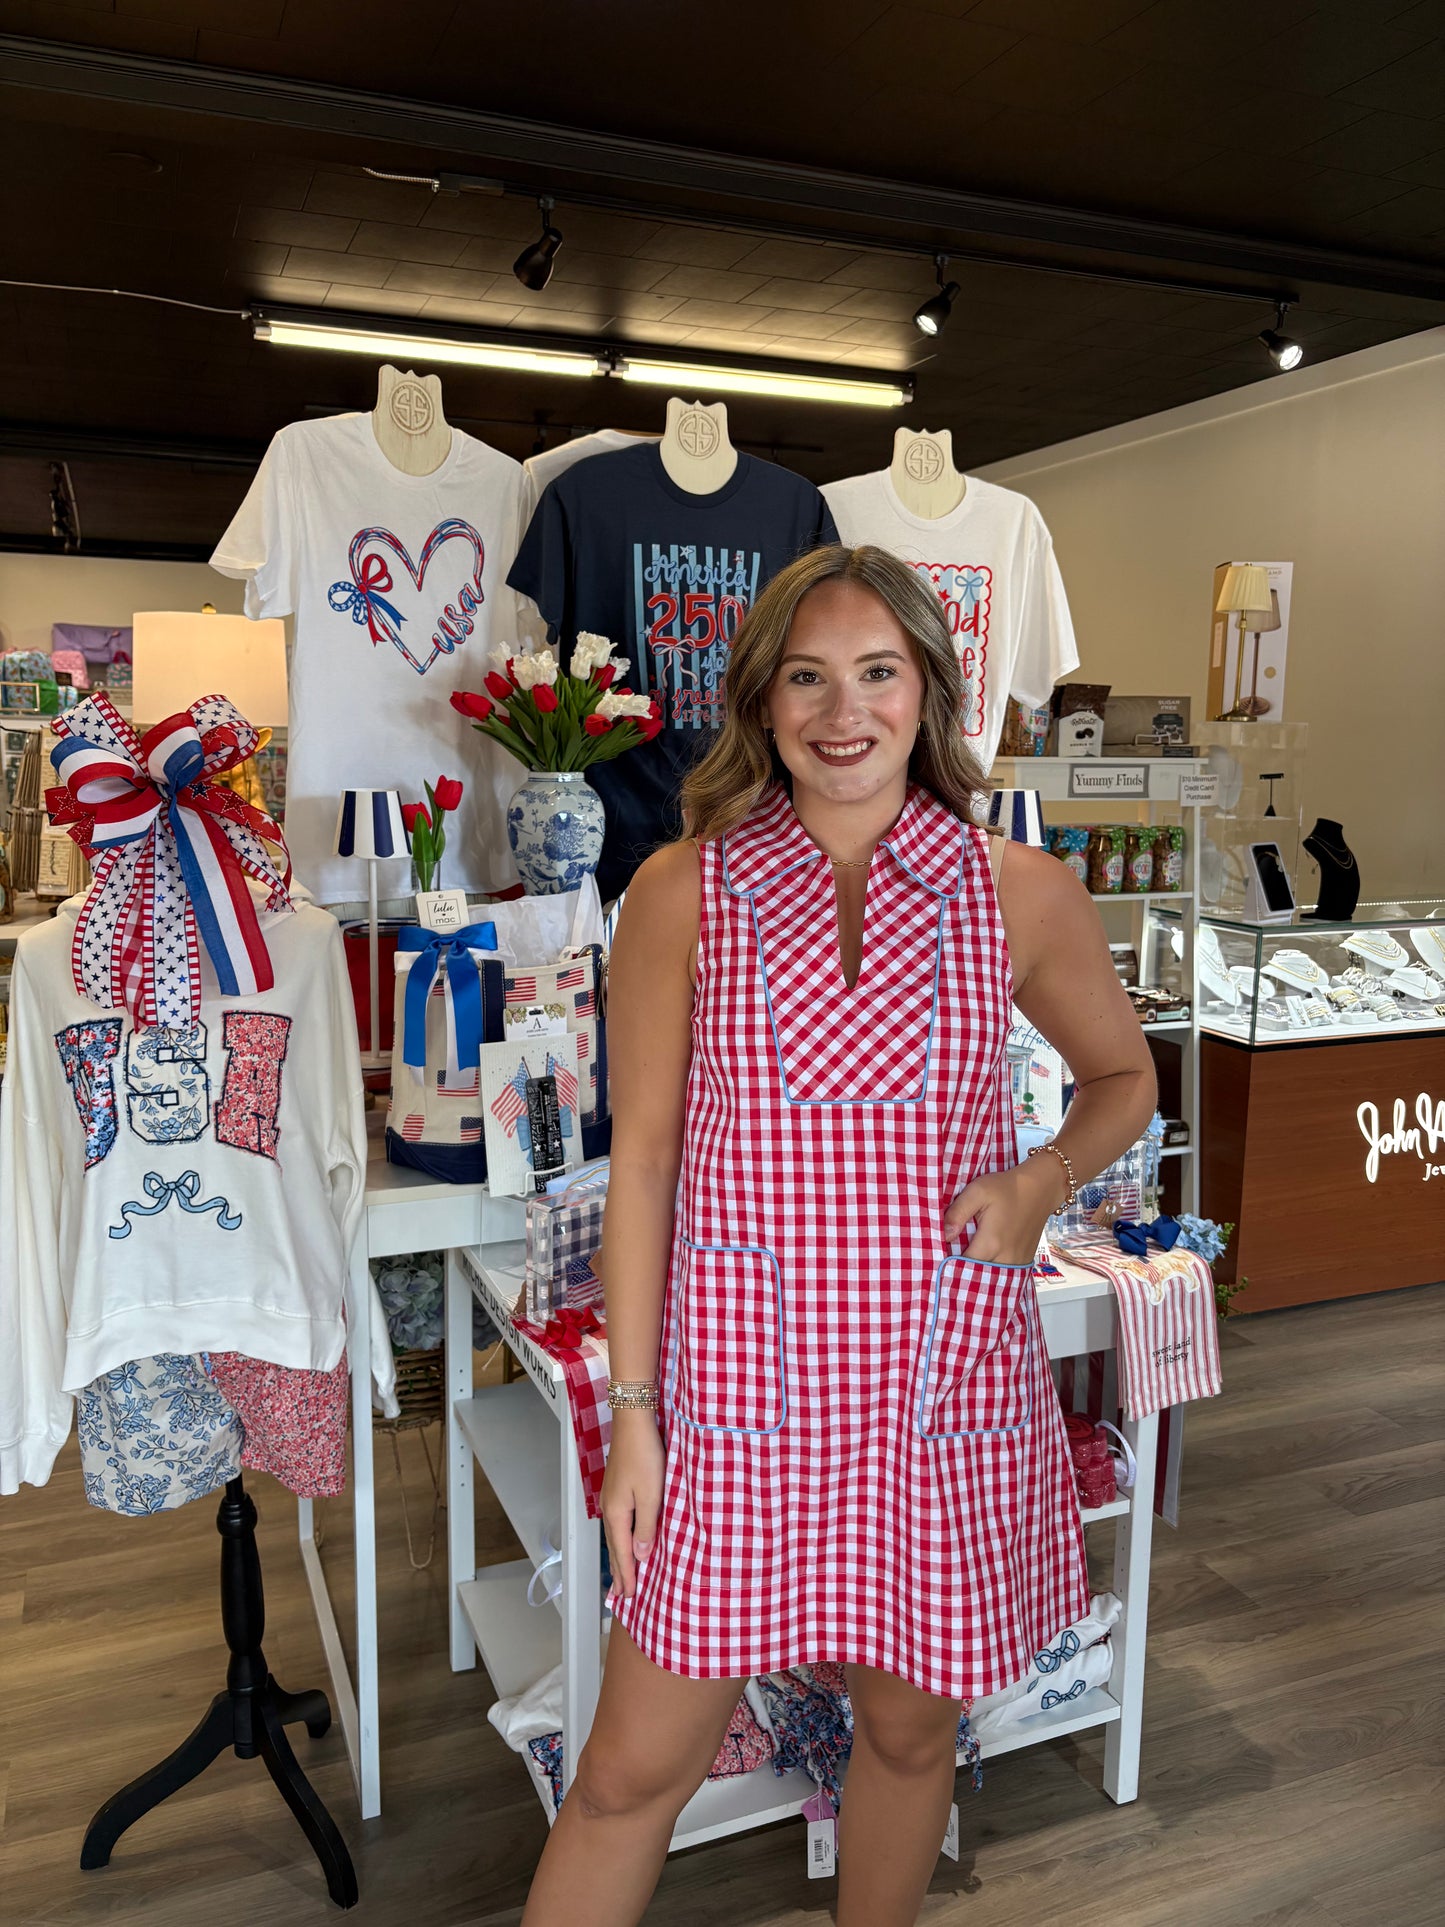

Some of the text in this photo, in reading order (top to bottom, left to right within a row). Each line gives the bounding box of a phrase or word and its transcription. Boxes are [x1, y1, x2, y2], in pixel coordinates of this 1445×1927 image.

[644, 554, 751, 592] America
[432, 583, 484, 655] usa
[646, 592, 746, 650] 250
[672, 678, 727, 719] freed
[1075, 773, 1143, 788] Yummy Finds
[433, 901, 455, 914] lulu
[435, 917, 456, 925] mac
[1356, 1100, 1425, 1183] John
[462, 1252, 557, 1399] MICHEL DESIGN WORKS
[1152, 1336, 1191, 1357] sweet land
[1155, 1352, 1189, 1368] of liberty
